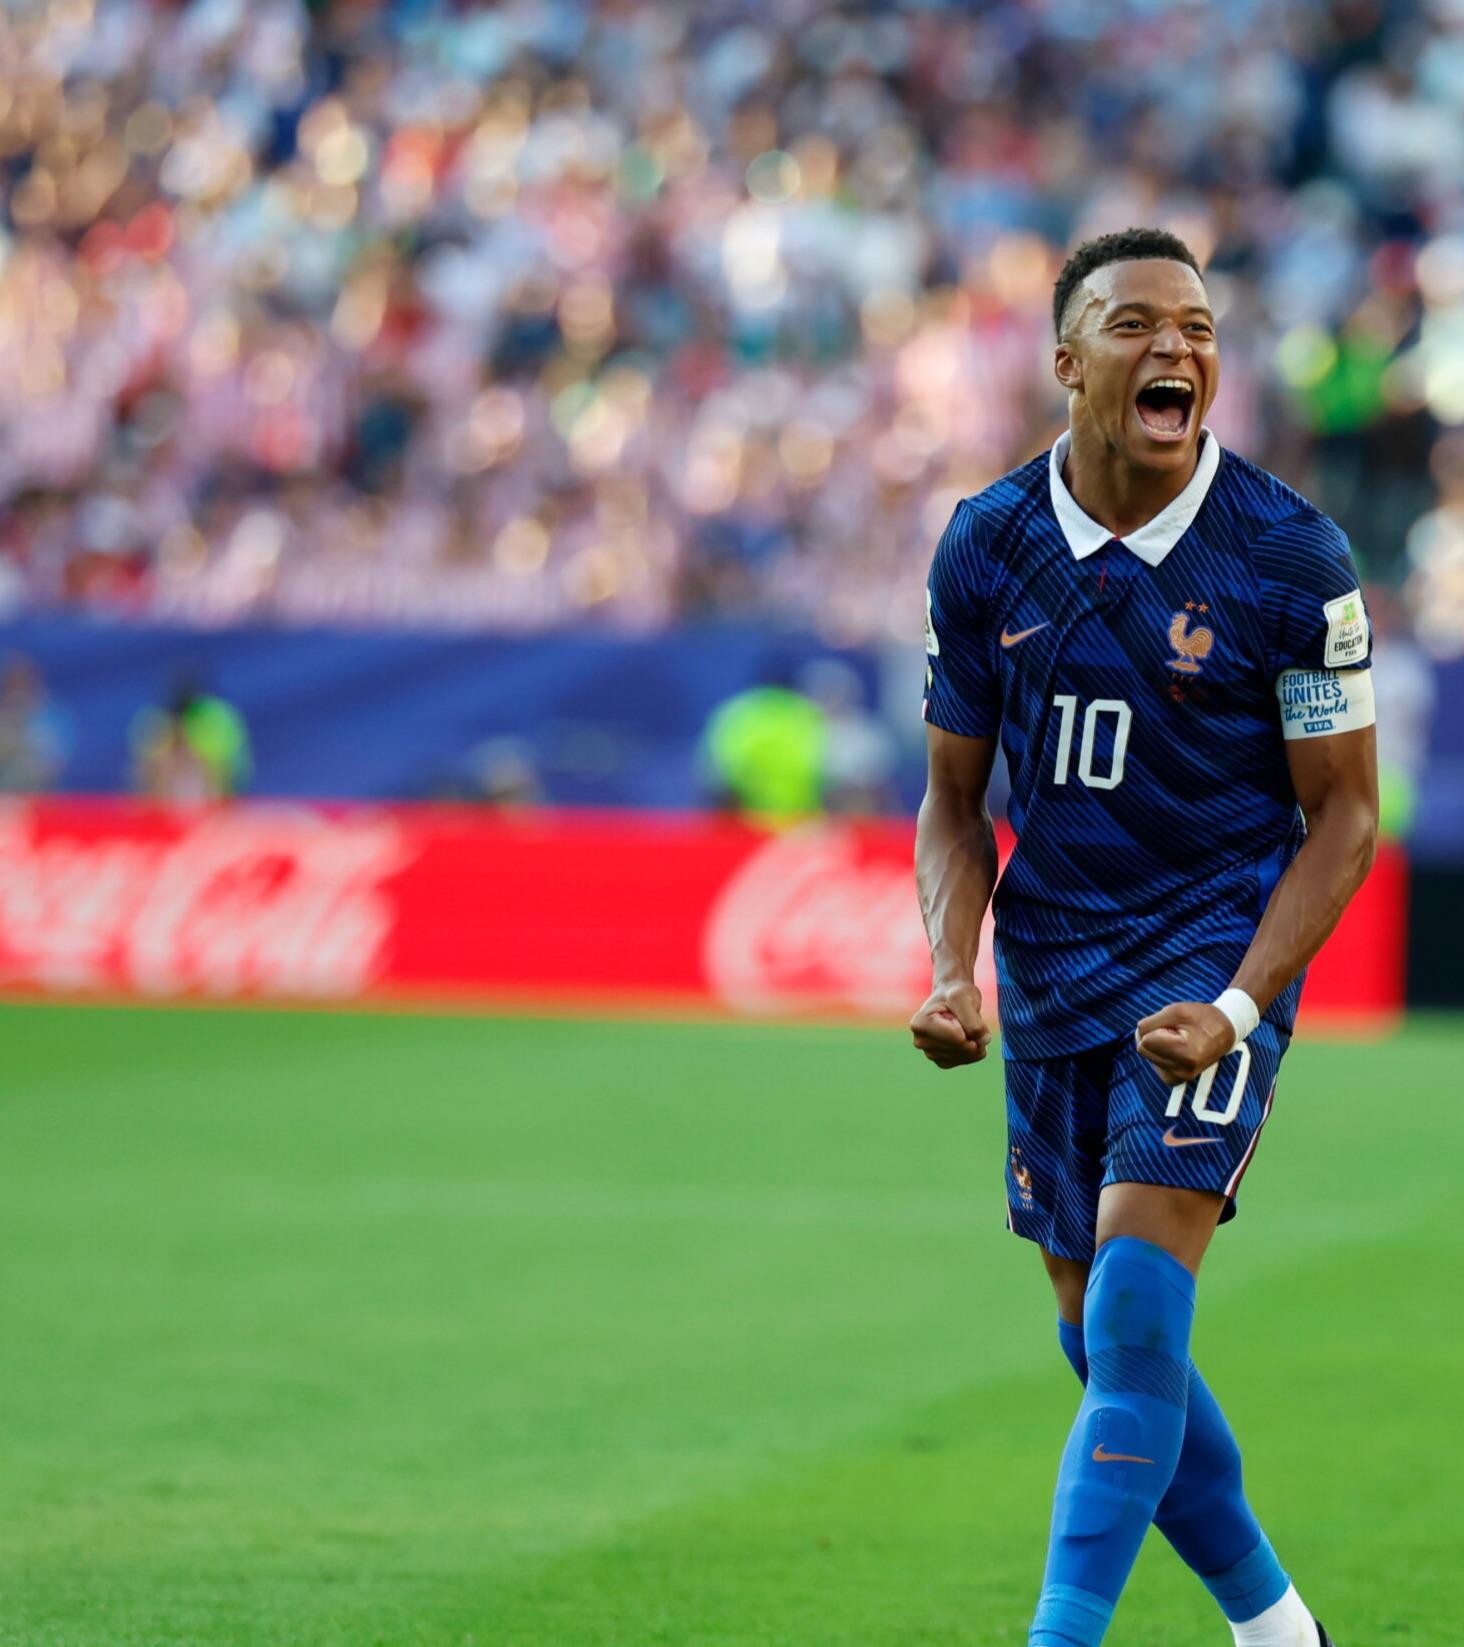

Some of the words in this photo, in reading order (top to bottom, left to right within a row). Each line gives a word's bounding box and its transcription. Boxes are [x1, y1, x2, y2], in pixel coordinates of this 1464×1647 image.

[1283, 670, 1339, 687] FOOTBALL
[1283, 681, 1343, 705] UNITES
[1284, 707, 1306, 721] the
[1308, 698, 1348, 719] World
[1305, 721, 1332, 732] FIFA
[1053, 694, 1133, 790] 10
